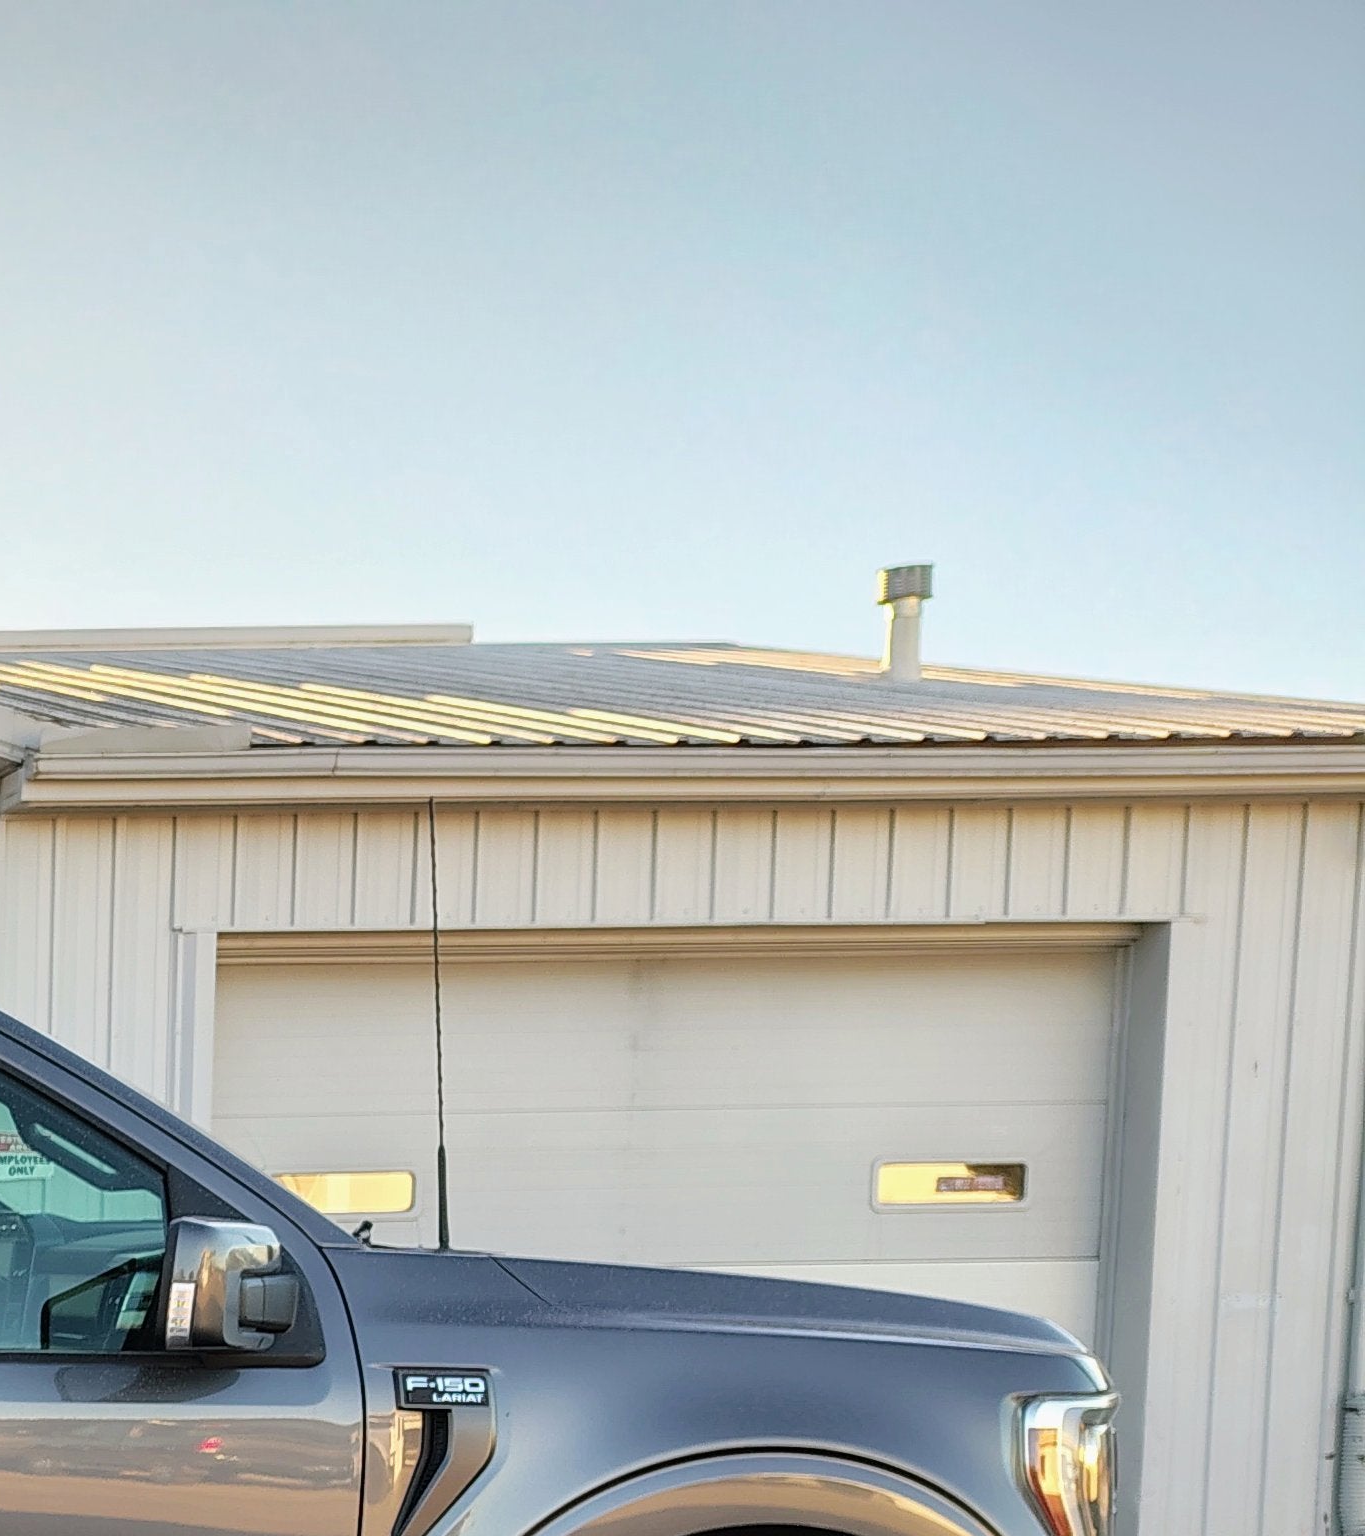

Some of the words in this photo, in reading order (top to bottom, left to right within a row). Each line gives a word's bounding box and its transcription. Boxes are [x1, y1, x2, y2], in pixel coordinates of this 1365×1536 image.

[9, 1166, 35, 1176] ONLY
[405, 1376, 485, 1393] F-150
[432, 1392, 484, 1404] LARIAT
